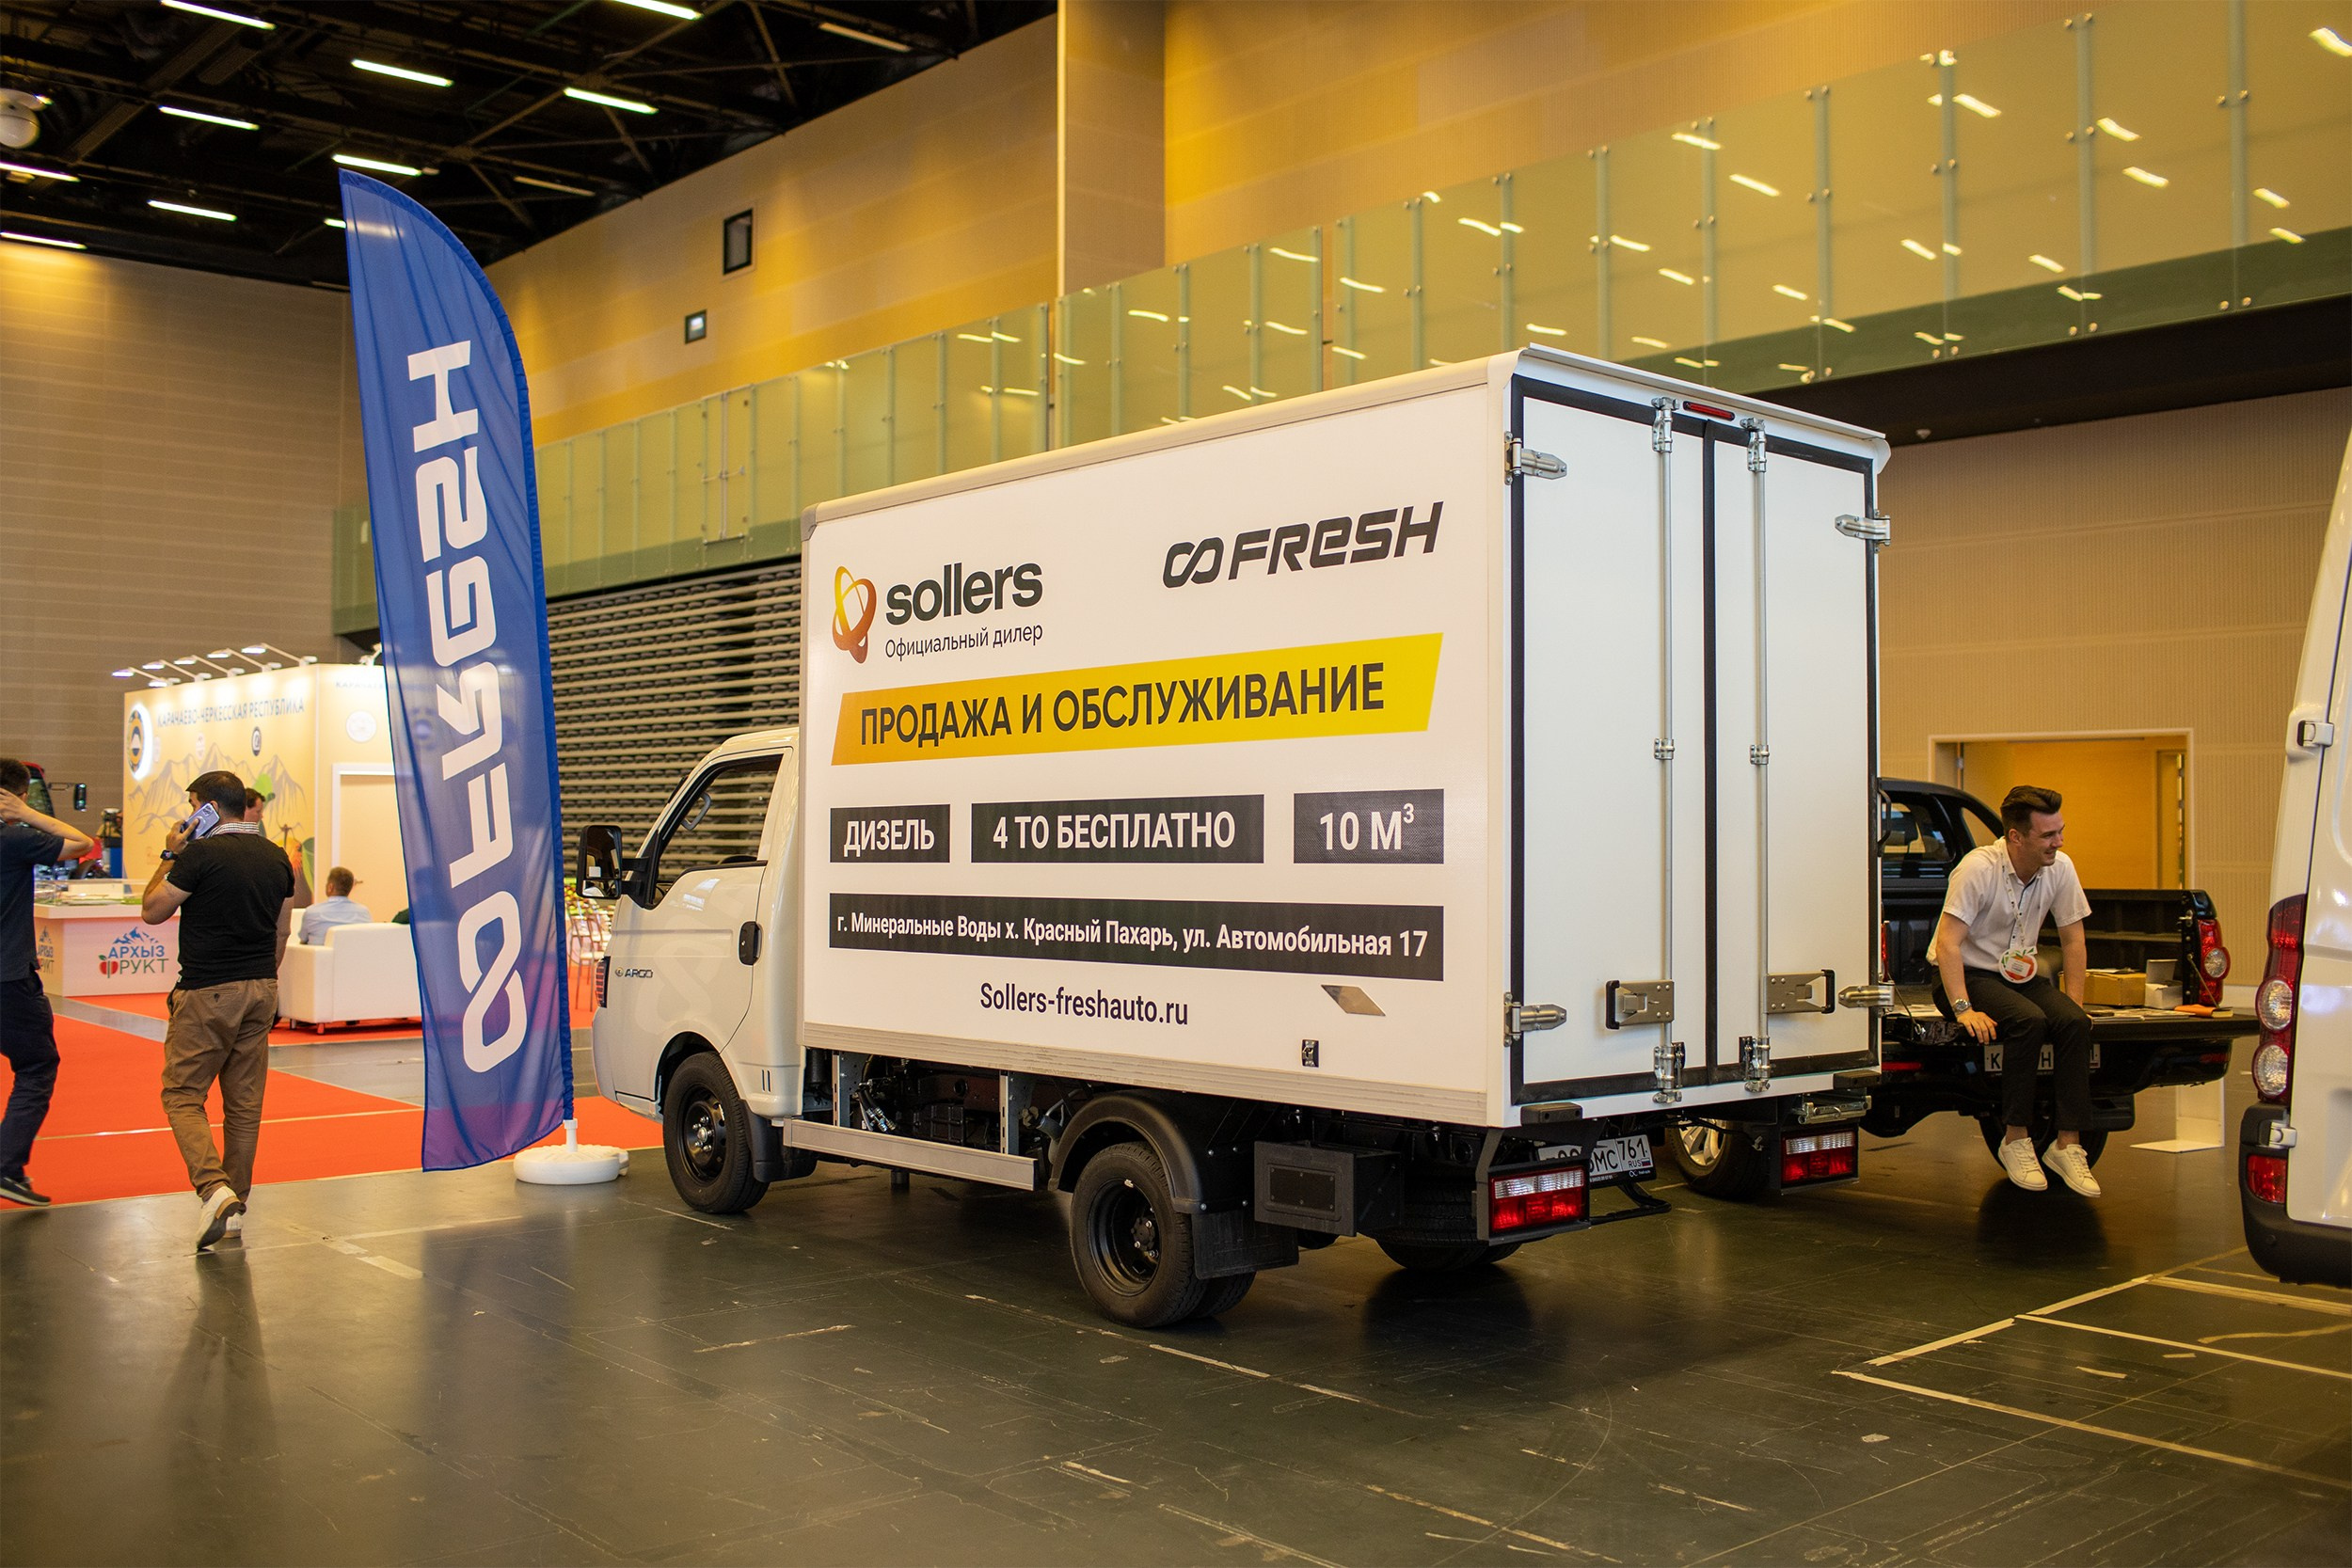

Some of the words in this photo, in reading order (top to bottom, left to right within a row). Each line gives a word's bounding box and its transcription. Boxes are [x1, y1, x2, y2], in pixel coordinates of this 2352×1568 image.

[885, 562, 1043, 626] sollers
[885, 626, 989, 661] Официальный
[993, 624, 1043, 648] дилер
[248, 699, 305, 719] РЕСПУБЛИКА
[860, 693, 1012, 749] ПРОДАЖА
[1022, 694, 1043, 734] И
[1053, 661, 1385, 732] ОБСЛУЖИВАНИЕ
[844, 818, 936, 857] ДИЗЕЛЬ
[993, 816, 1009, 849] 4
[1015, 815, 1049, 848] ТО
[1057, 811, 1236, 848] БЕСПЛАТНО
[1319, 811, 1359, 851] 10
[107, 944, 166, 958] АРХЫЗ
[837, 915, 848, 932] г.
[850, 912, 954, 939] Минеральные
[957, 915, 1001, 942] Воды
[1005, 921, 1019, 940] х.
[1024, 917, 1101, 945] Красный
[1105, 920, 1178, 952] Пахарь,
[1183, 927, 1211, 953] ул.
[1216, 924, 1391, 956] Автомобильная
[1399, 930, 1428, 957] 17
[980, 982, 1188, 1025] Sollers-freshauto.ru
[1617, 1137, 1646, 1161] 761
